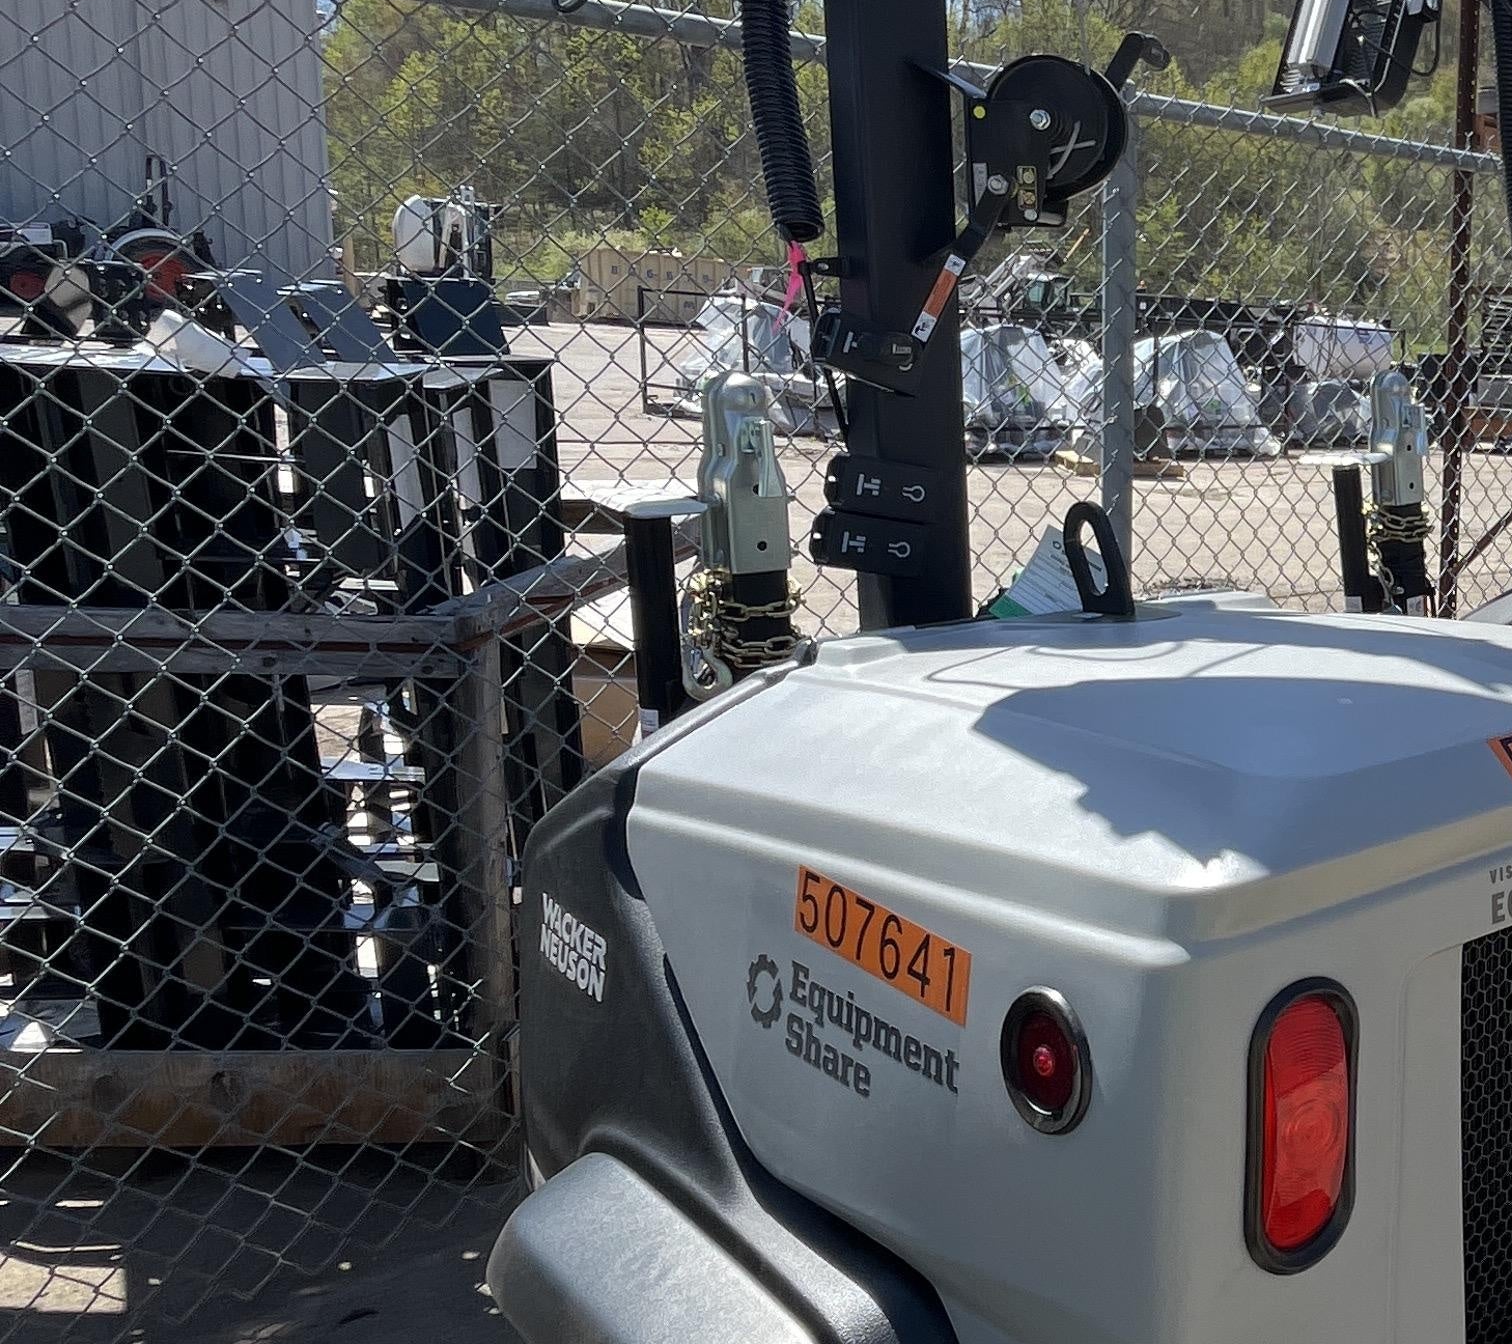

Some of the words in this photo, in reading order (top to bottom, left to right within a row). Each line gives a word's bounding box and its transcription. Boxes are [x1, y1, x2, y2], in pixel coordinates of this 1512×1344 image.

[540, 923, 606, 1003] NEUSON
[541, 892, 607, 972] WACKER
[799, 870, 957, 1013] 507641
[785, 1012, 872, 1098] Share
[789, 959, 961, 1095] Equipment
